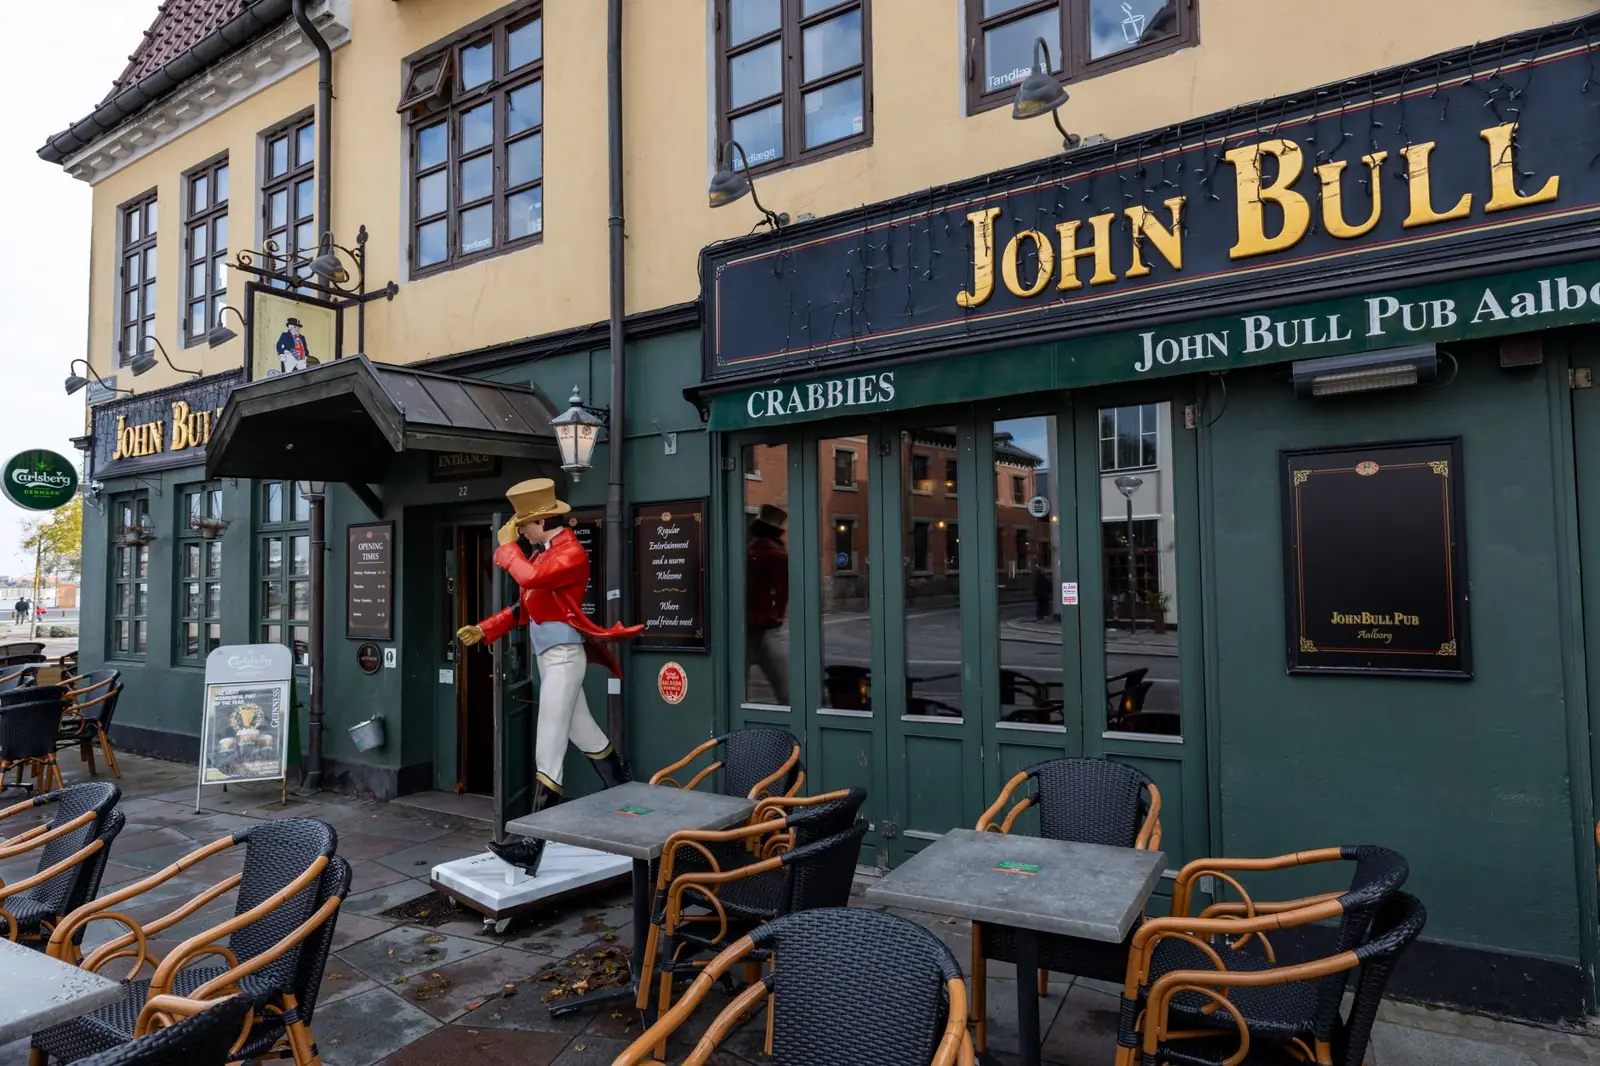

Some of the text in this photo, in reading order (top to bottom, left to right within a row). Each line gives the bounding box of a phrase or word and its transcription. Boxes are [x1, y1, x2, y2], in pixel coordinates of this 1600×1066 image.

[988, 63, 1047, 88] Tandlæe
[732, 149, 775, 168] Tadlæge
[956, 122, 1560, 308] JOHN BULL
[1134, 330, 1229, 373] JOHN
[1241, 314, 1351, 353] BULL
[1364, 296, 1457, 337] PUB
[747, 372, 895, 418] CRABBIES
[112, 400, 224, 460] JOHN BUL
[12, 468, 71, 488] Carlsberg
[458, 486, 468, 496] 22
[657, 524, 680, 539] Regular
[358, 542, 384, 550] OPENING
[648, 540, 689, 550] Entertainment
[362, 552, 380, 560] TIMES
[652, 555, 665, 565] and
[656, 570, 682, 580] Welcome
[660, 600, 680, 610] Where
[645, 615, 693, 630] good friends meet
[1394, 611, 1421, 626] PUB
[1357, 628, 1393, 644] Aalborg
[227, 655, 272, 669] Carlsberg
[271, 688, 280, 728] GUINNESS
